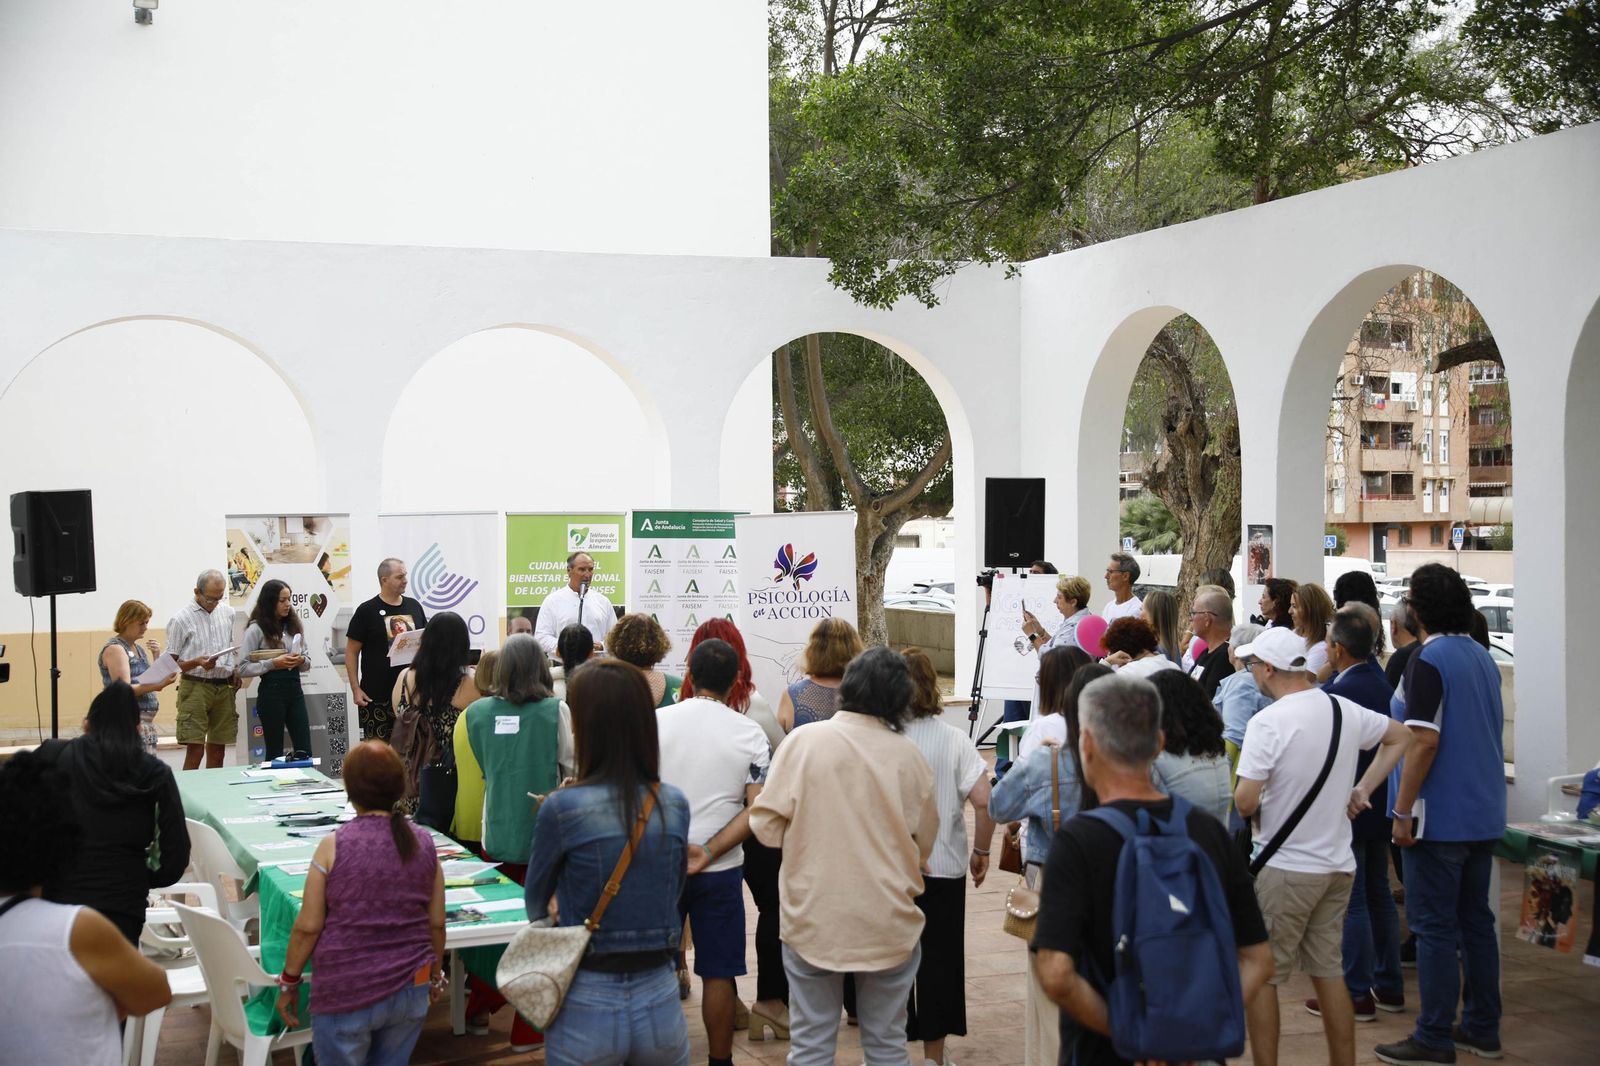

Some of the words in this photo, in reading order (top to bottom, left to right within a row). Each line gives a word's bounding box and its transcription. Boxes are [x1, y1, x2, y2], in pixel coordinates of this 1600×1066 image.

[528, 562, 567, 570] CUIDAM
[509, 574, 561, 583] BIENESTAR
[514, 586, 528, 595] DE
[529, 586, 548, 595] LOS
[747, 586, 851, 604] PSICOLOGÍA
[753, 608, 765, 618] en
[767, 602, 832, 619] ACCIÓN
